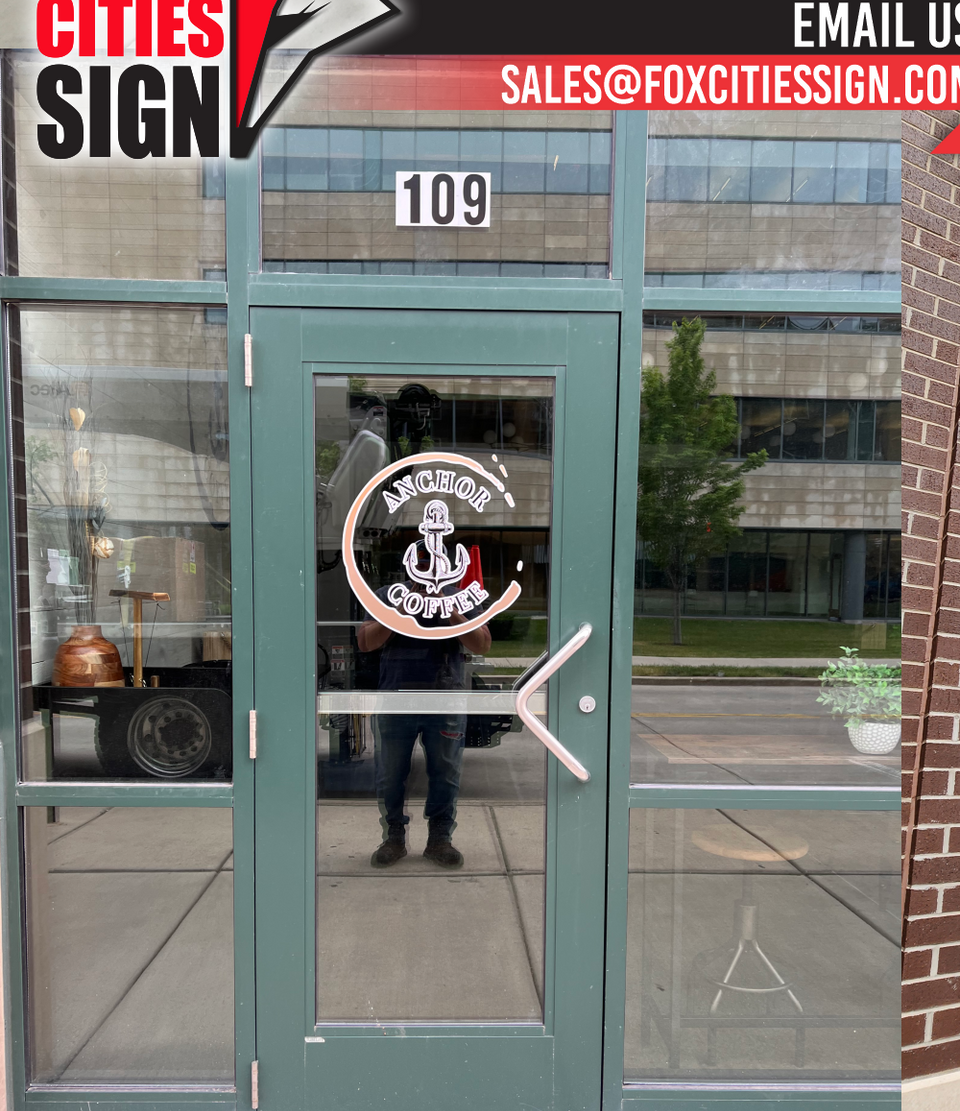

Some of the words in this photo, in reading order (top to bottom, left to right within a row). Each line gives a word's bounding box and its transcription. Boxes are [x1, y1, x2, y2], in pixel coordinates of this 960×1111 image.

[403, 173, 487, 226] 109
[382, 469, 492, 514] ANCHOR
[387, 580, 490, 618] COFFEE
